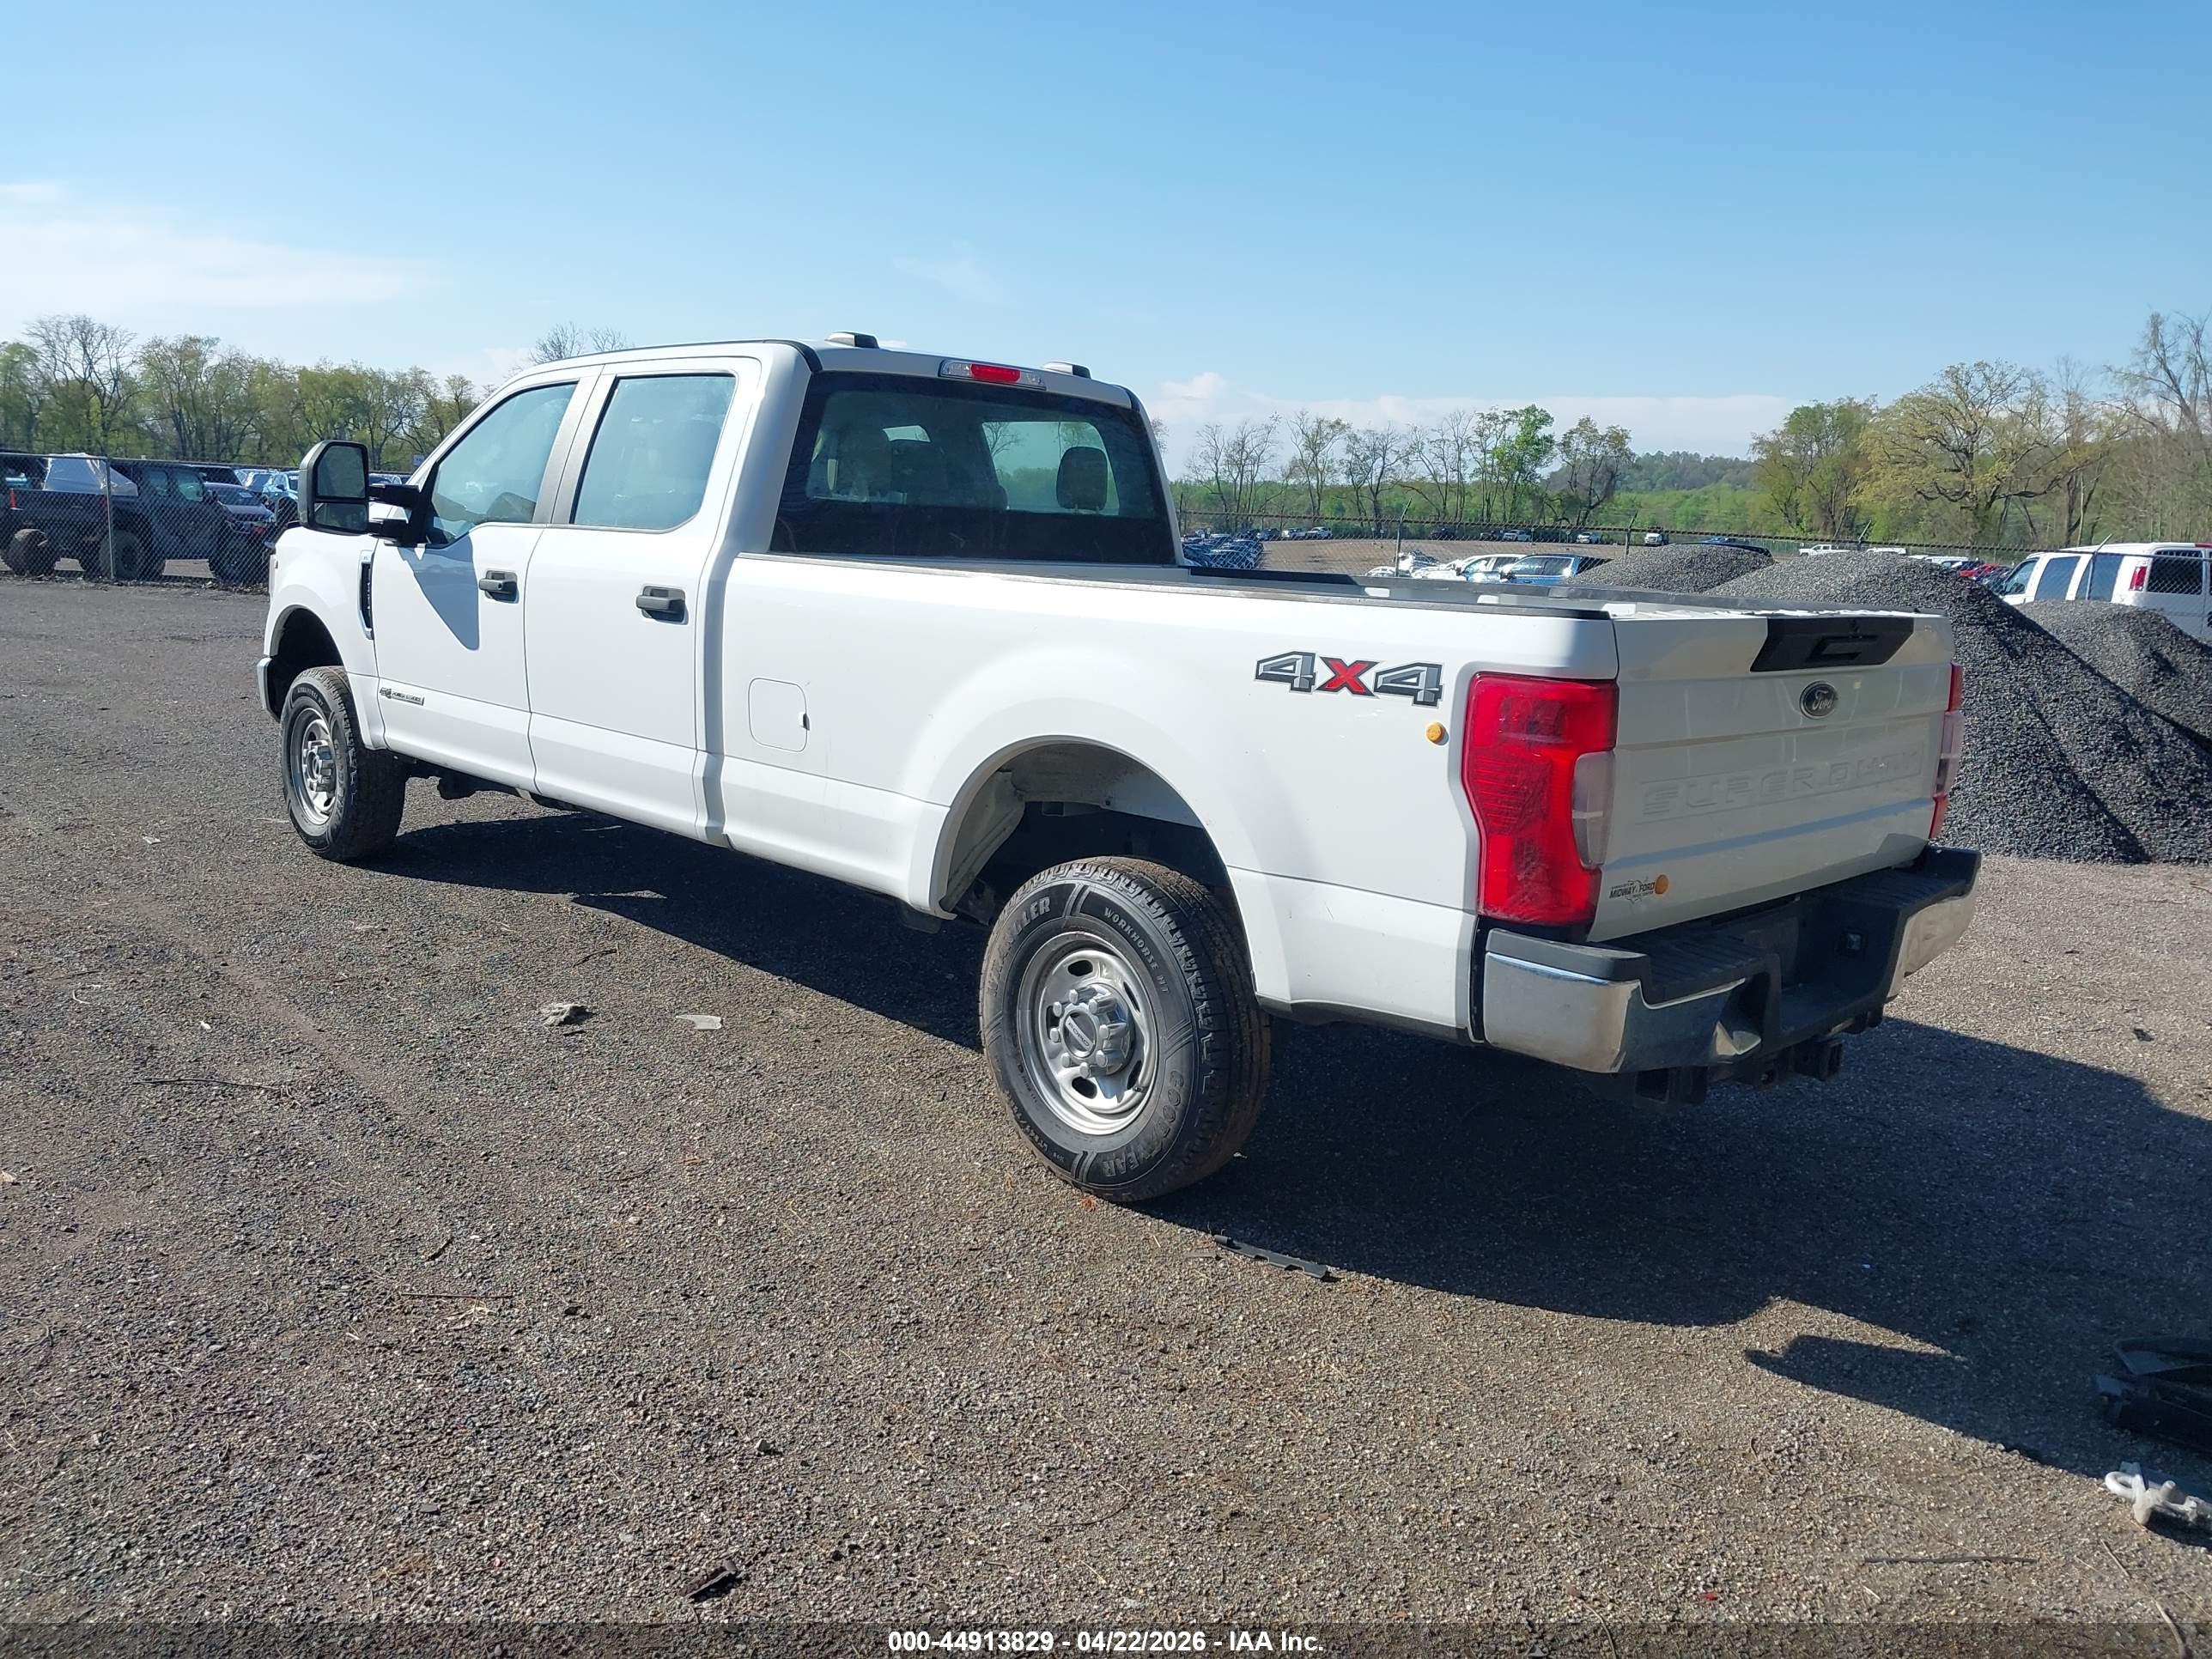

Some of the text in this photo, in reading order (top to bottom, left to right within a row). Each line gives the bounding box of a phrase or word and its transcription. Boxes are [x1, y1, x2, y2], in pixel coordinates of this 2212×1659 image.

[1813, 690, 1833, 710] Ford
[1643, 768, 1814, 816] SUPER
[1639, 882, 1656, 893] FORD
[1103, 907, 1159, 970] WORKHORSE
[1067, 1021, 1091, 1047] FORD
